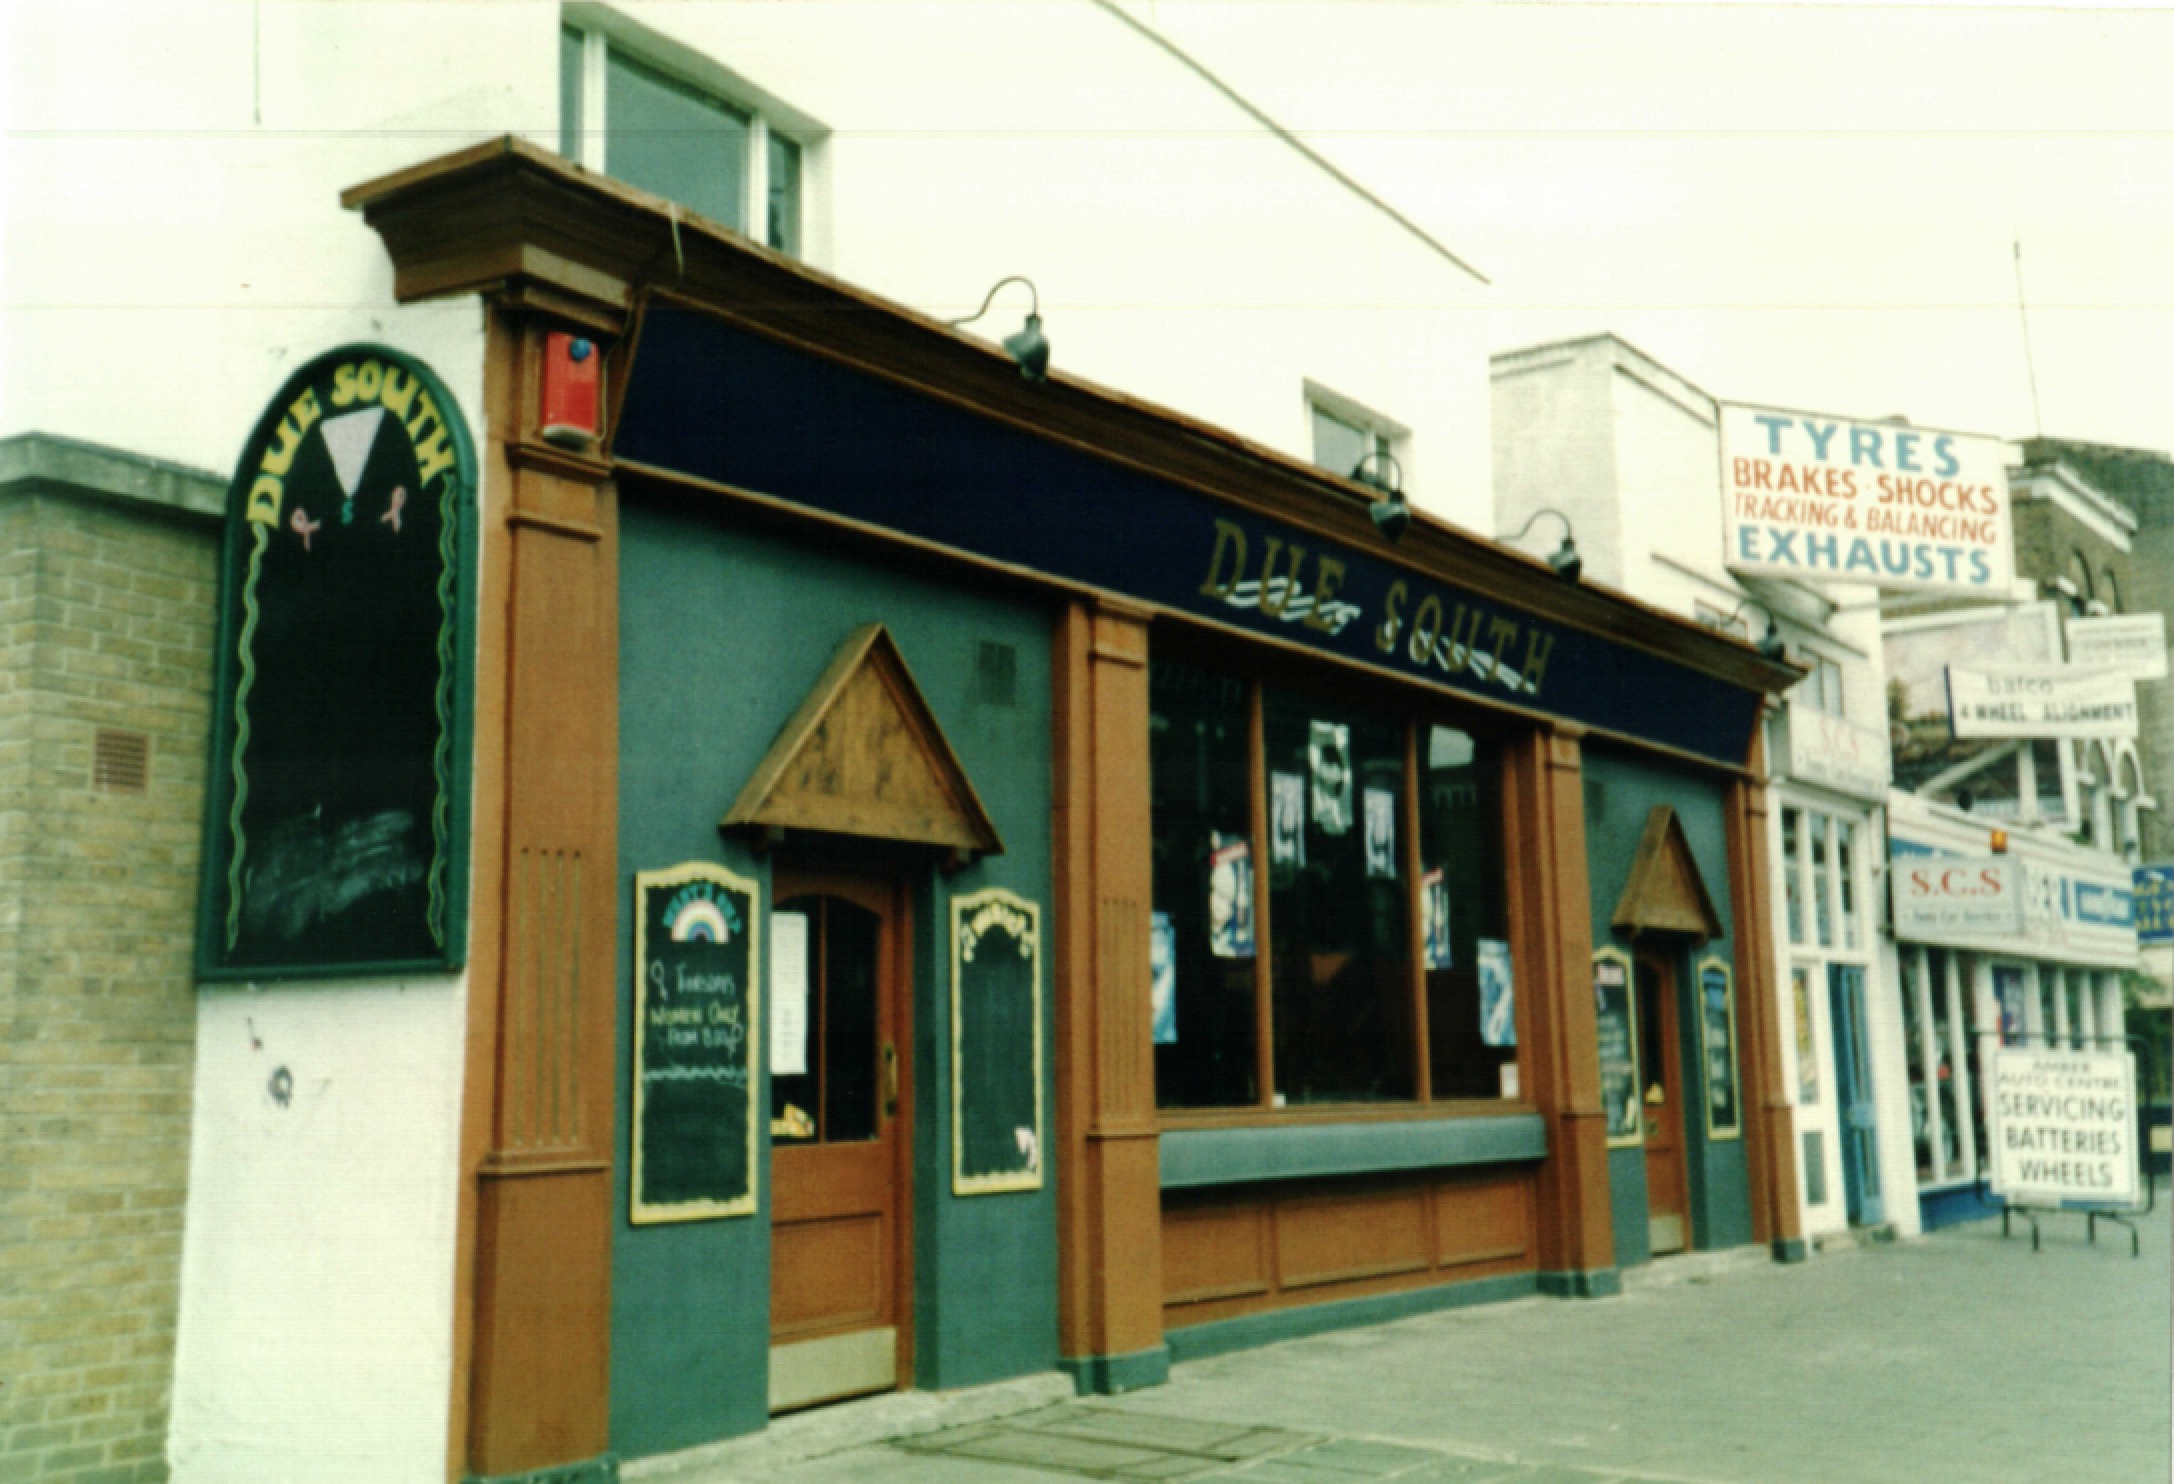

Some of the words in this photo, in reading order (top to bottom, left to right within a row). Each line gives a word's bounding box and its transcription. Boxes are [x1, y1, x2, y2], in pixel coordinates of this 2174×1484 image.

[331, 359, 456, 488] SOUTH
[1754, 414, 1960, 477] TYRES
[1733, 457, 1858, 499] BRAKES
[1877, 474, 1999, 515] SHOCKS
[1734, 492, 1838, 529] TRACKING
[1844, 507, 1858, 530] &
[1866, 508, 1997, 544] BALANCING
[1738, 525, 1991, 585] EXHAUSTS
[1375, 580, 1554, 695] SOUTH
[1999, 1093, 2125, 1122] SERVICING
[2006, 1125, 2121, 1155] BATTERIES
[2020, 1157, 2114, 1187] WHEELS
